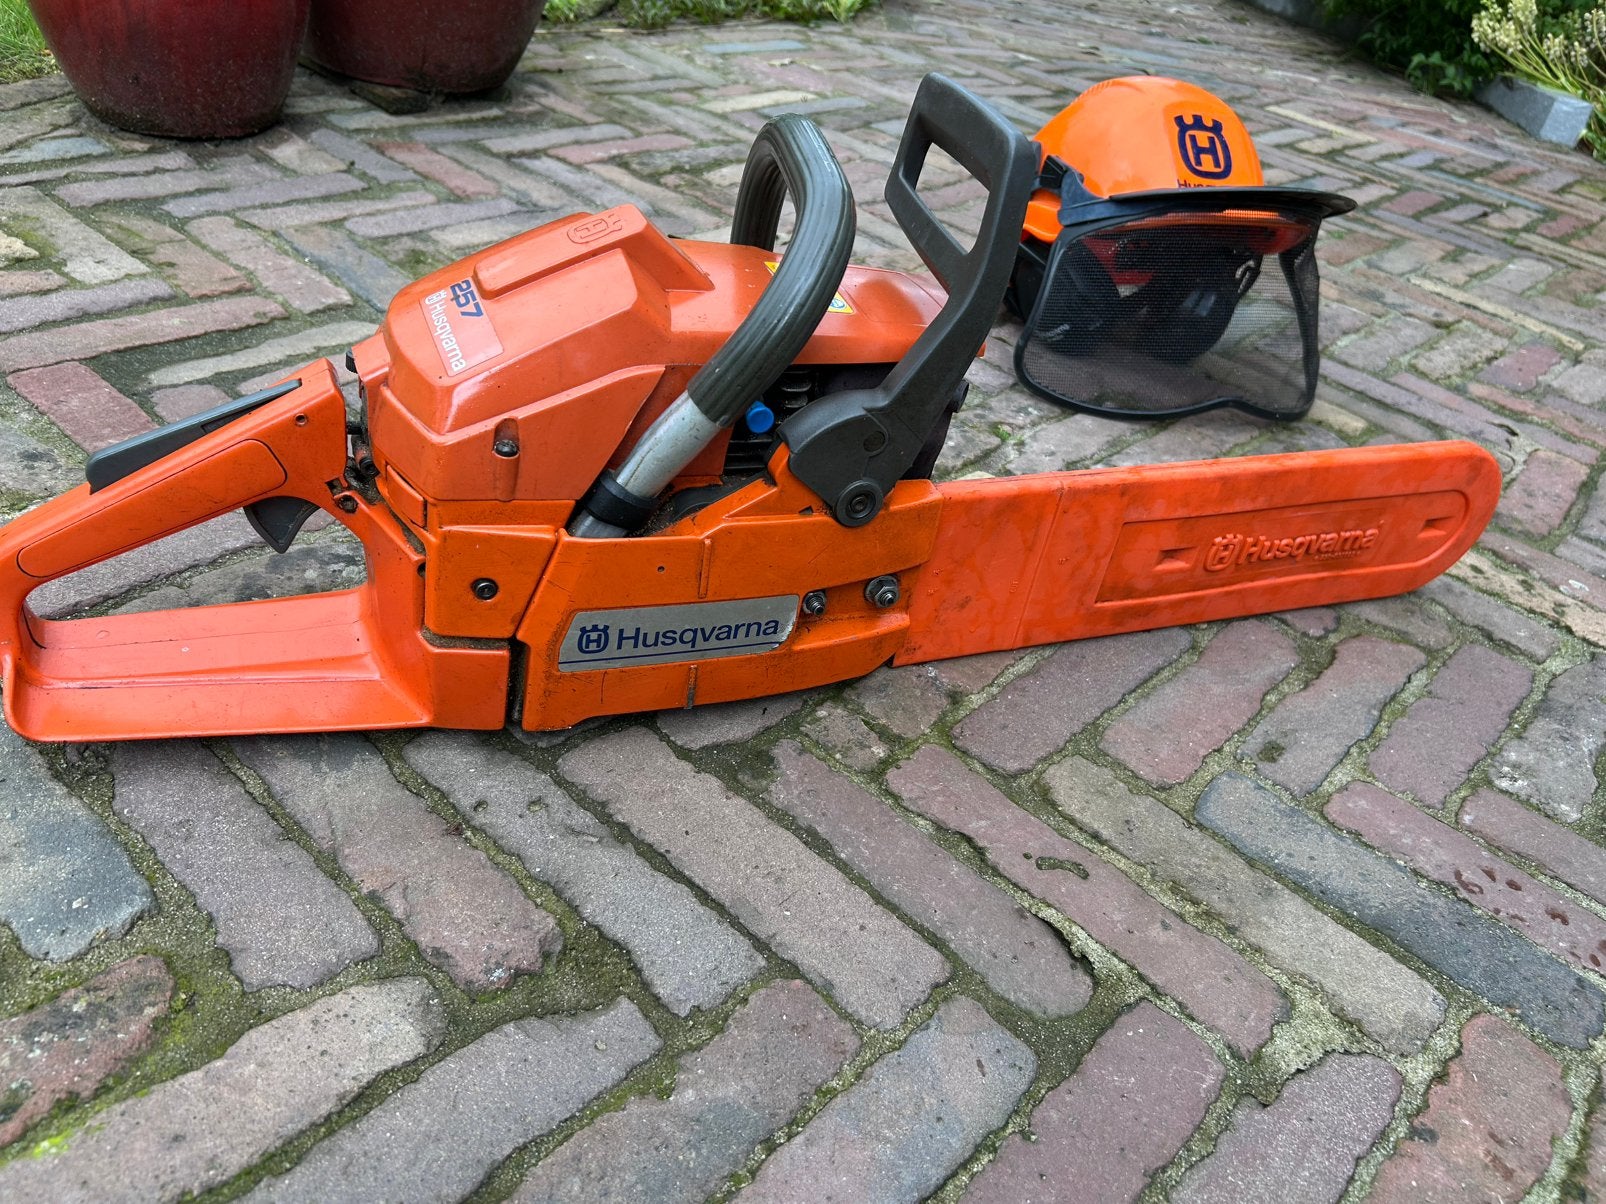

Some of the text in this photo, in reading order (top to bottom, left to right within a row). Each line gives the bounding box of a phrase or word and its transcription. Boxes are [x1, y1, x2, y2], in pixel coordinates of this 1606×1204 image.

[450, 279, 484, 317] 257
[429, 301, 467, 372] Husqvarna
[1236, 528, 1379, 565] Husqvarna
[616, 619, 780, 650] Husqvarna
